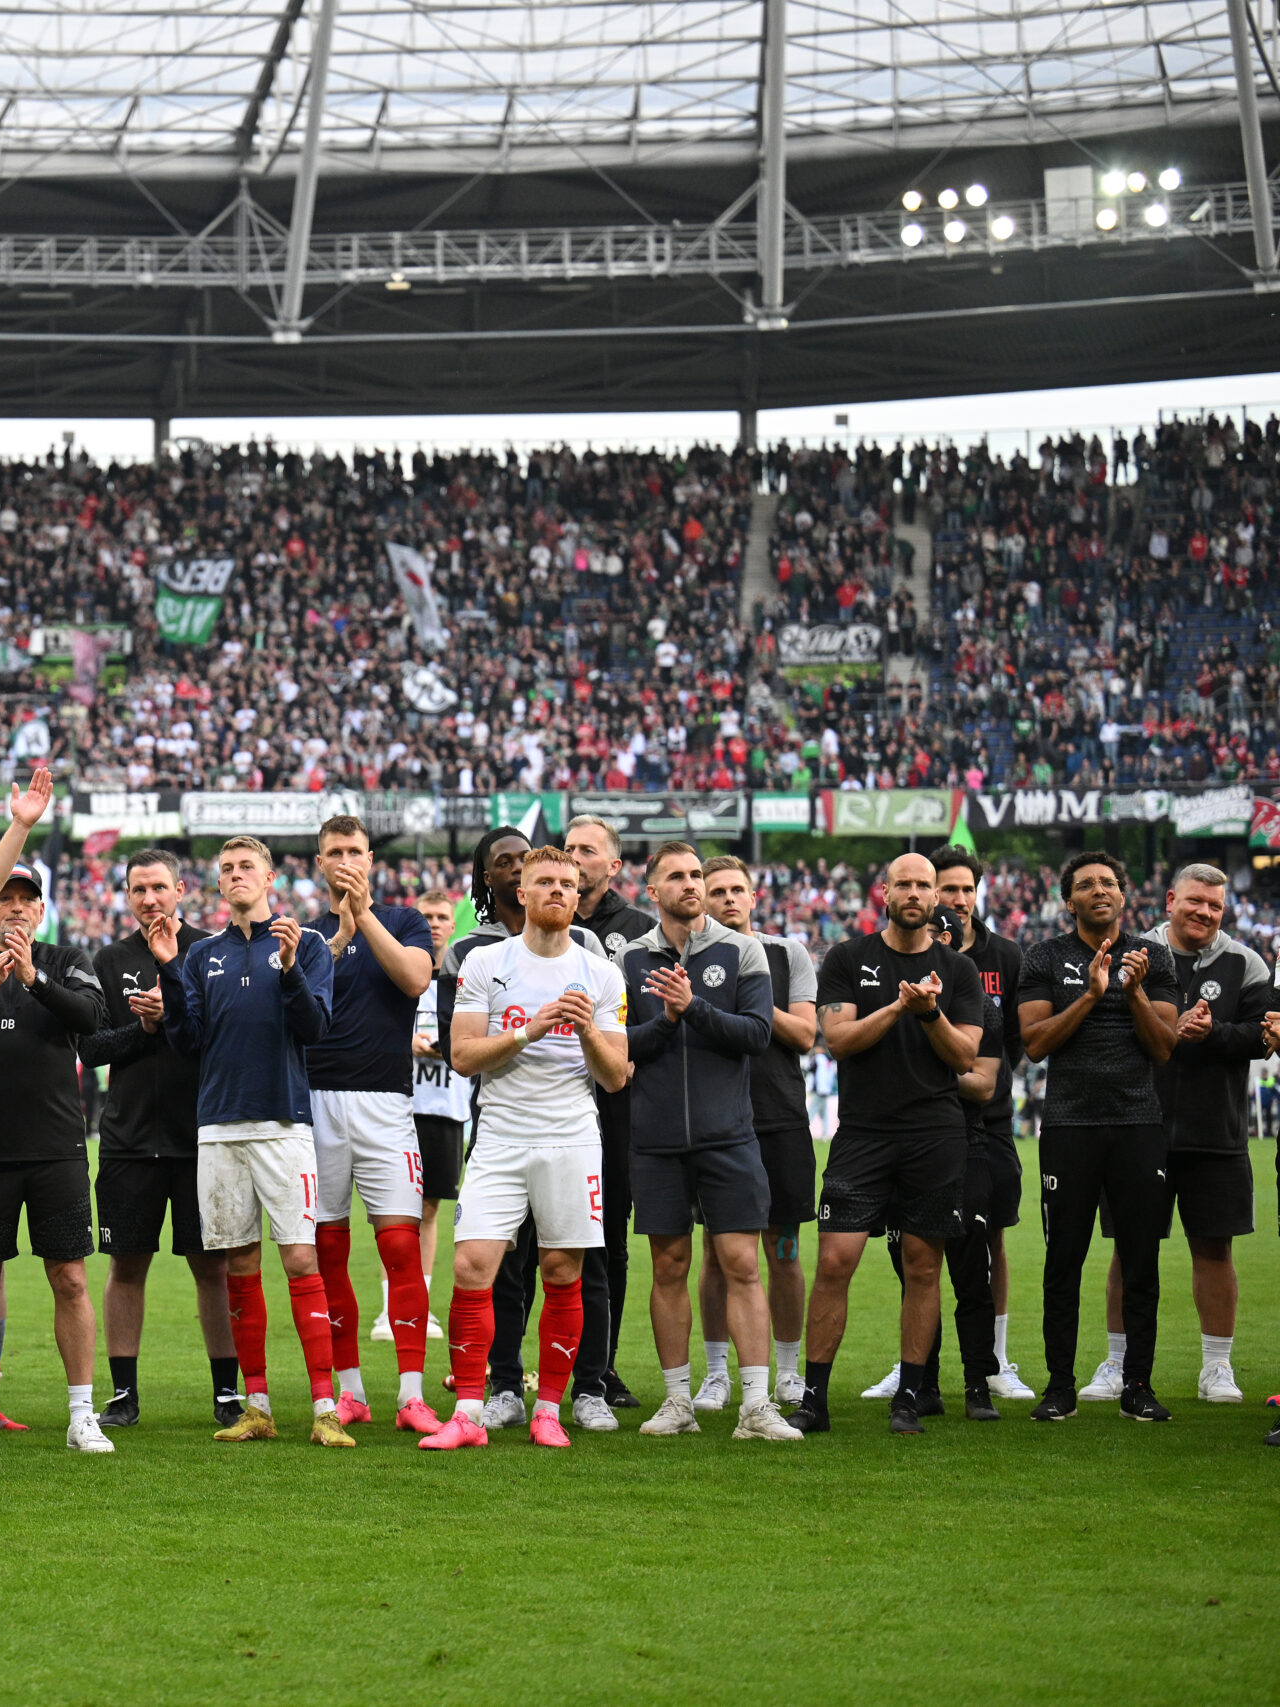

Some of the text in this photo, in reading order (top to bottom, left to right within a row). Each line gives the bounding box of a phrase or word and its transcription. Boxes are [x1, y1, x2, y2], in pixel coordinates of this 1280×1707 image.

[347, 945, 356, 955] 19
[240, 976, 250, 987] 11
[1, 1018, 15, 1030] DB
[501, 1005, 576, 1037] fala
[100, 1227, 112, 1243] TR
